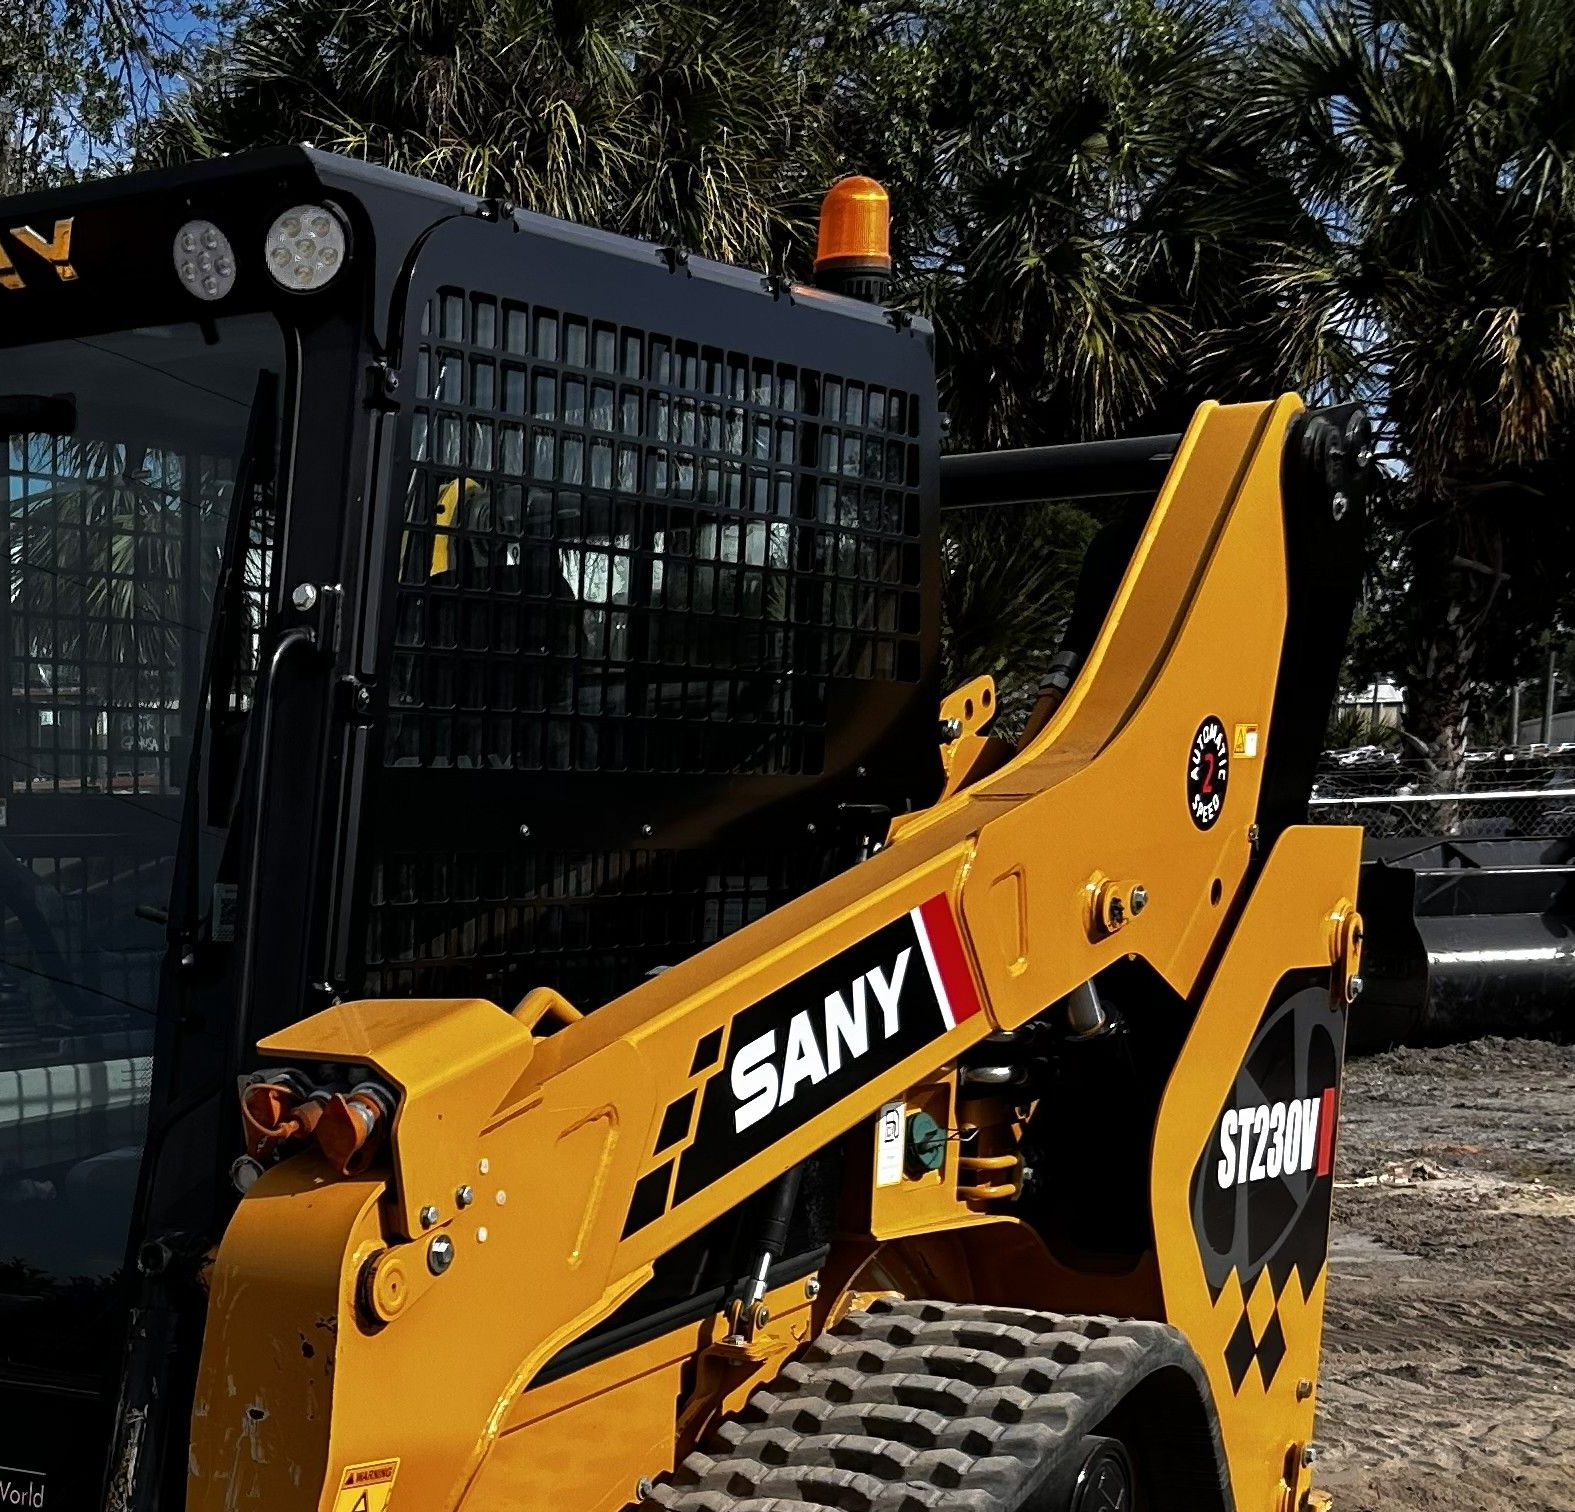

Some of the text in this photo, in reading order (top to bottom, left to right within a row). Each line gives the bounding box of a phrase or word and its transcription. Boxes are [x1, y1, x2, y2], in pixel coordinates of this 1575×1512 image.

[1190, 722, 1228, 781] AUTOMATIC
[1202, 752, 1214, 794] 2
[1191, 793, 1220, 823] SPEED
[729, 946, 913, 1135] SANY
[1217, 1096, 1321, 1190] ST230V
[356, 1466, 393, 1482] WARNING
